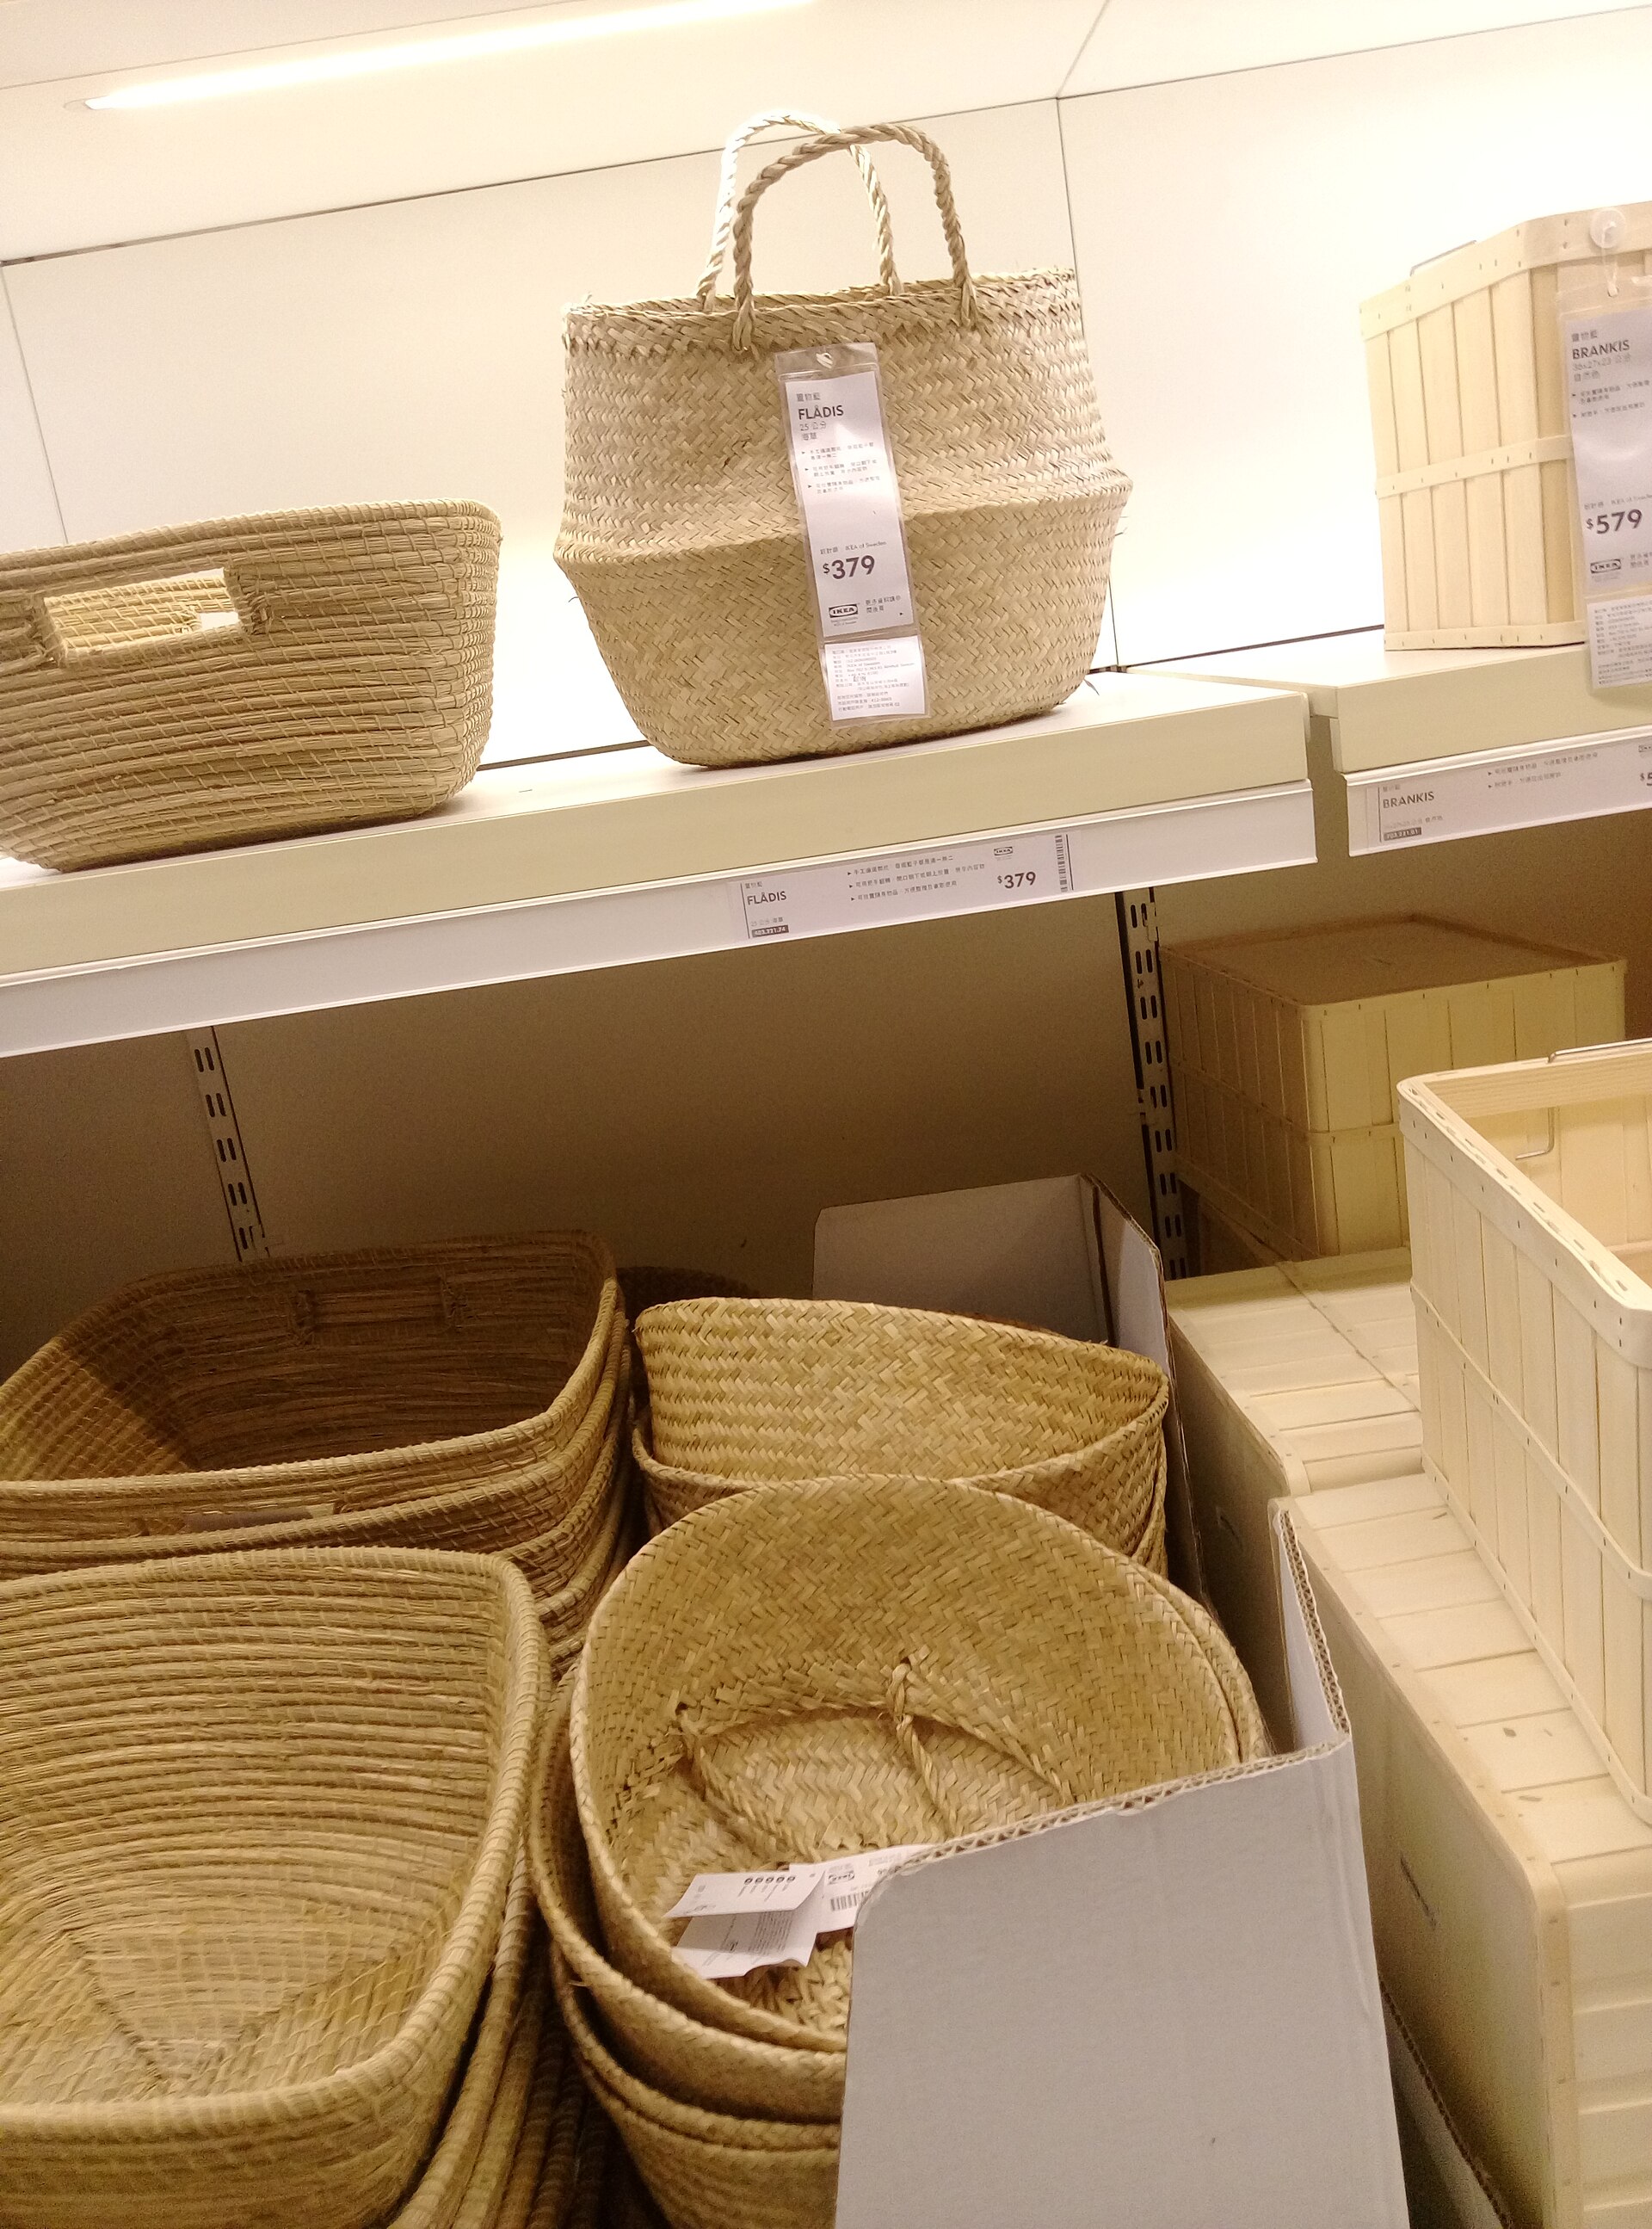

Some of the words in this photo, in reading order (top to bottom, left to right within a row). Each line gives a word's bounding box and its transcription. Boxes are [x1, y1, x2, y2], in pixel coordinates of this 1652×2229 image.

[1572, 340, 1630, 360] BRANKIS
[798, 404, 844, 421] FLÅDIS
[1586, 509, 1643, 534] $579
[823, 554, 875, 580] $379
[1383, 791, 1435, 809] BRANKIS
[997, 871, 1037, 889] $379
[747, 891, 787, 905] FLÅDIS
